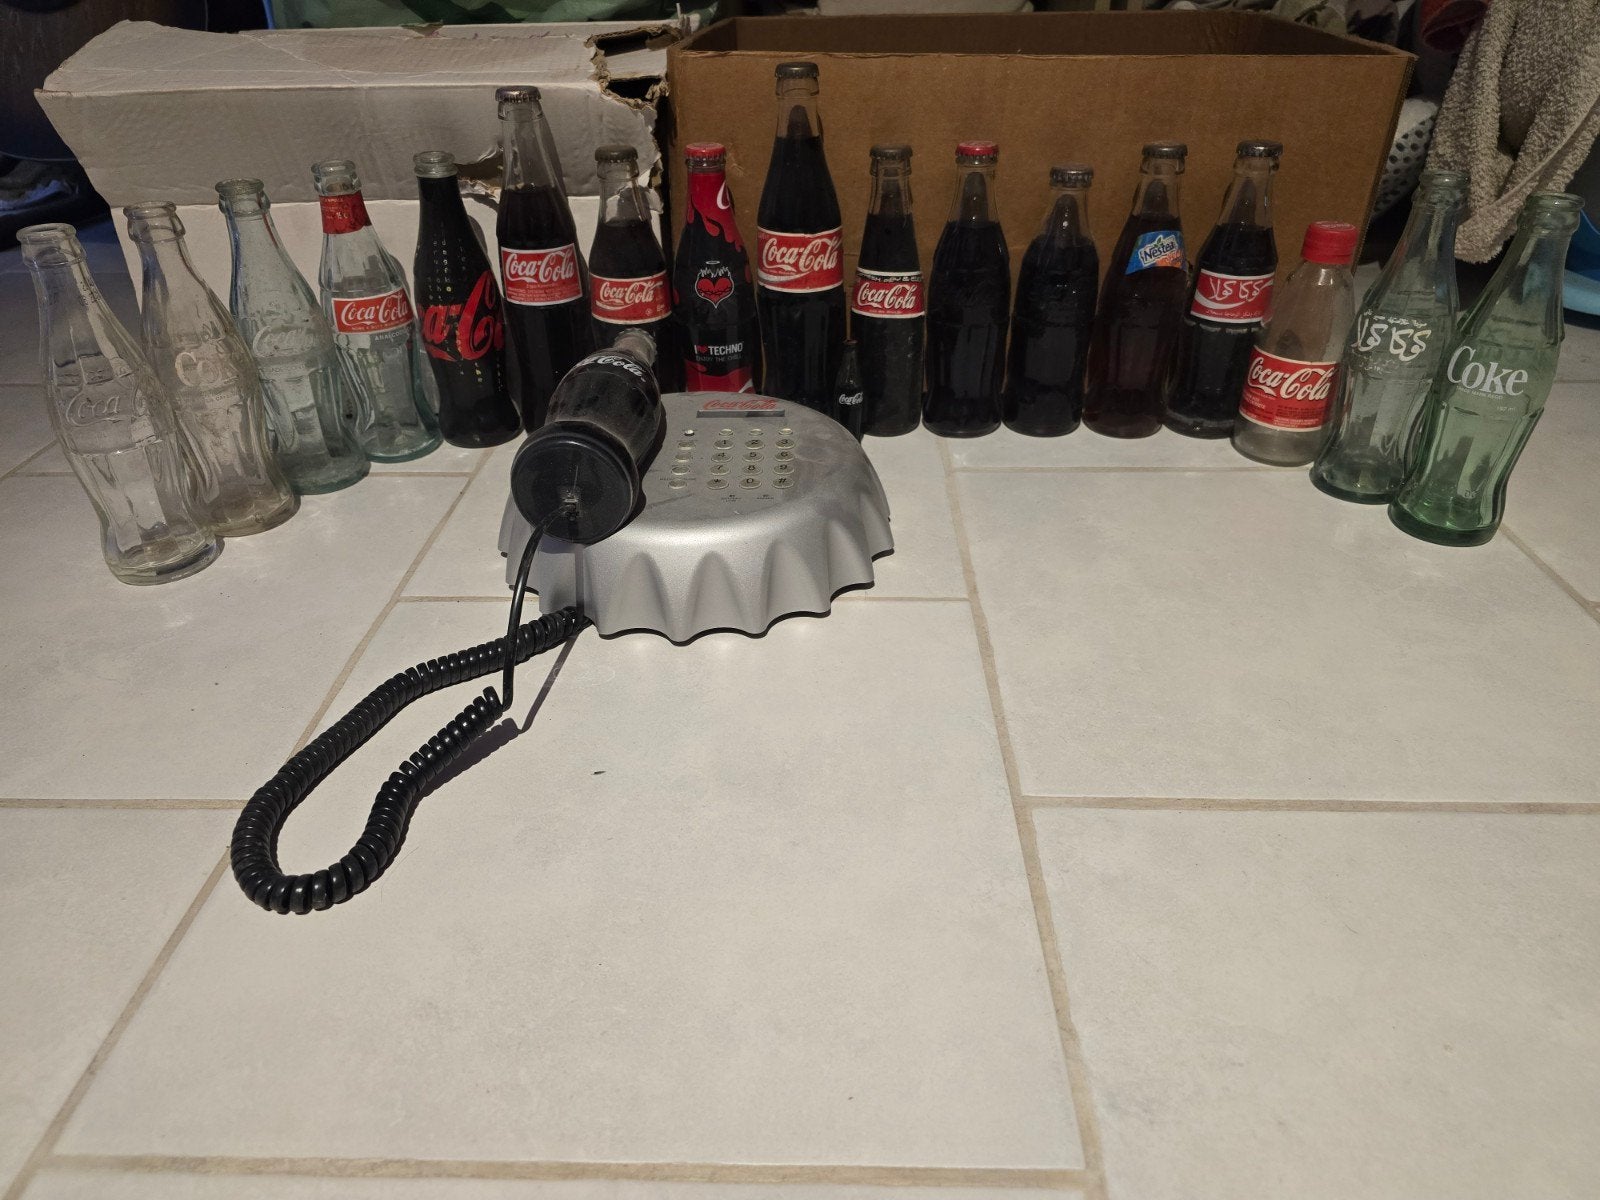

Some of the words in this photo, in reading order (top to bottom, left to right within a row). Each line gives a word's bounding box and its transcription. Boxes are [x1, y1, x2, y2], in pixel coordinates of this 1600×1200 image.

[506, 248, 574, 283] Coca-Cola
[762, 237, 841, 273] Coca-Cola
[1141, 241, 1174, 261] Nestea
[341, 293, 408, 326] Coca-Cola
[600, 281, 660, 305] Coca-Cola
[858, 282, 917, 309] Coca-Cola
[708, 342, 743, 356] TECHNO
[1351, 314, 1388, 352] كولا
[1389, 327, 1432, 361] كوكا
[1247, 356, 1335, 400] Coca-Cola
[1447, 346, 1528, 396] Coke
[704, 399, 777, 411] Coca-Cola
